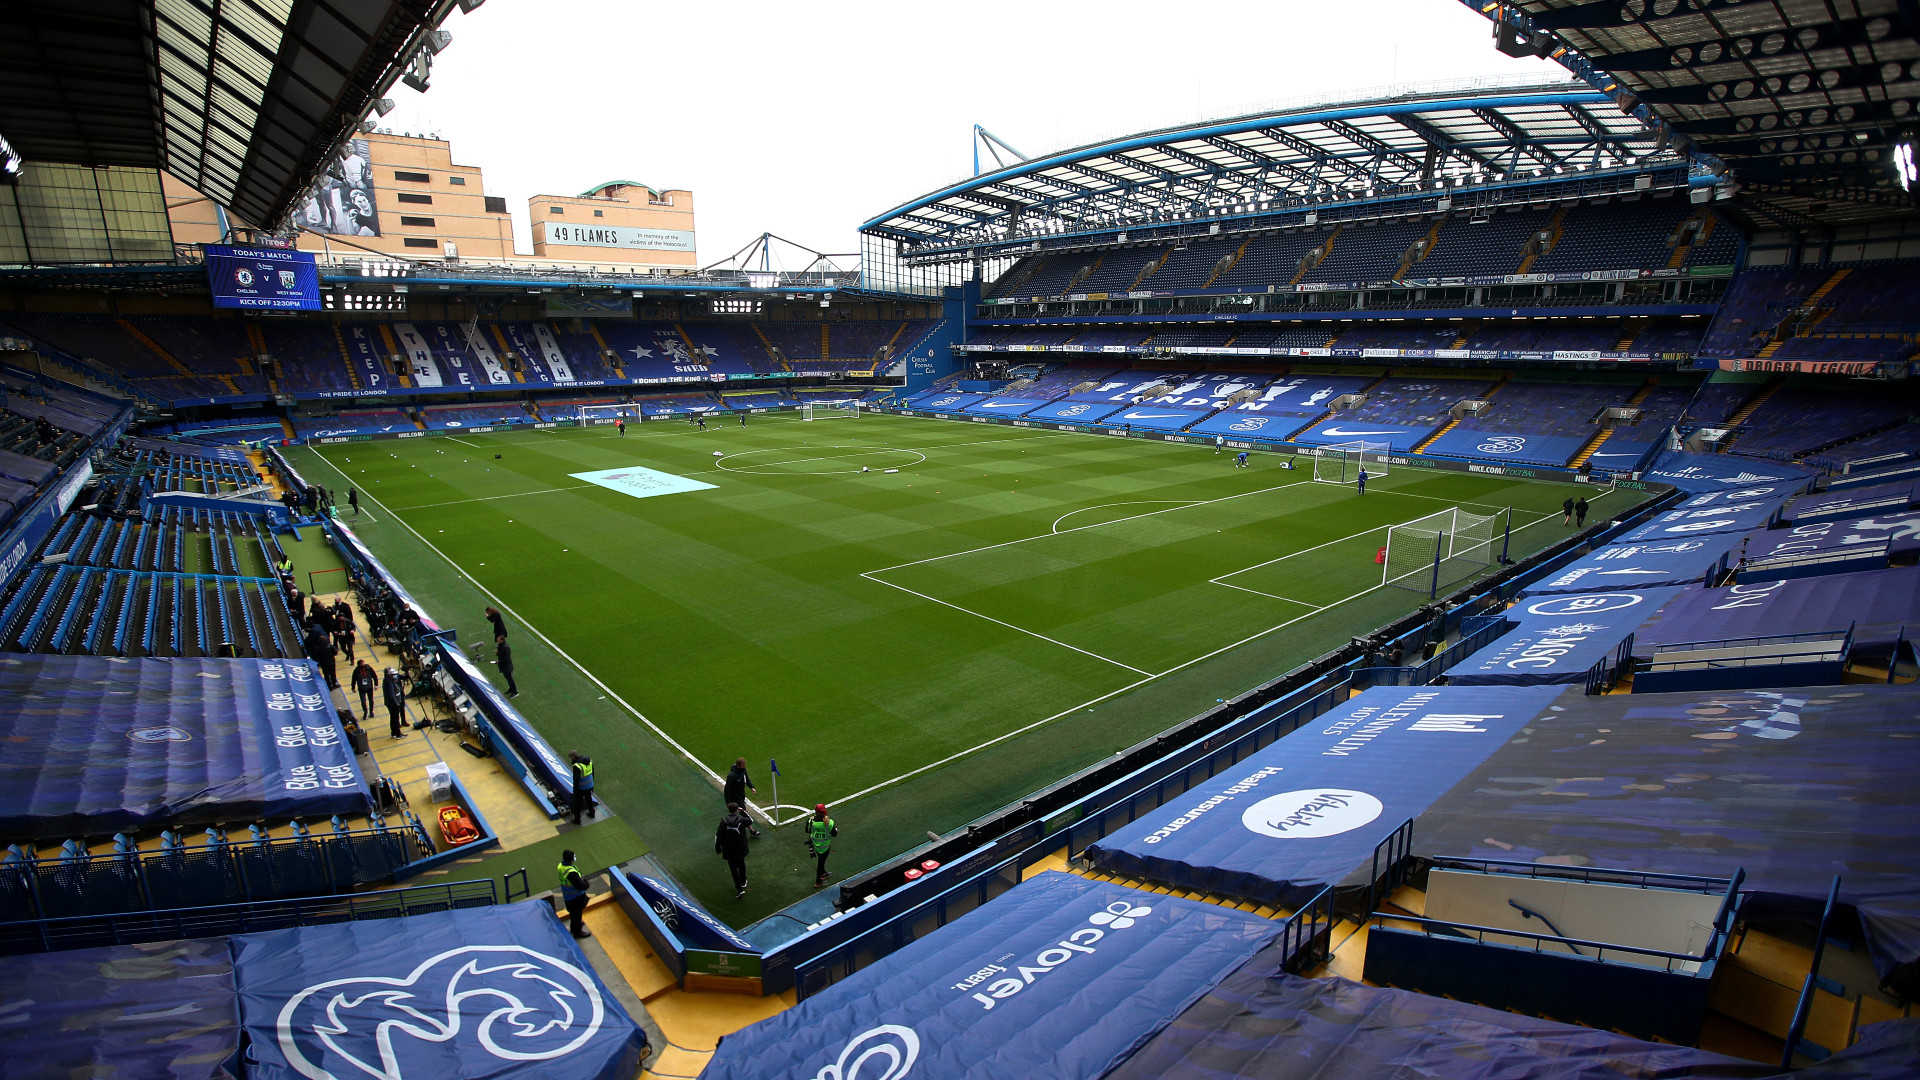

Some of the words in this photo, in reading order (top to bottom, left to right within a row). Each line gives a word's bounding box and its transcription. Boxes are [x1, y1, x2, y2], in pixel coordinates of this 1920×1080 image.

[259, 236, 285, 246] Three
[554, 227, 568, 240] 49
[575, 228, 618, 243] FLAMES
[233, 249, 265, 257] TODAY'S
[352, 327, 380, 386] KEEP
[404, 332, 430, 376] THE
[437, 326, 471, 384] BLUE
[508, 325, 549, 382] FLYING
[539, 327, 566, 378] HIGH
[1555, 352, 1589, 360] HASTINGS
[1746, 360, 1801, 372] DROGBA
[1812, 362, 1865, 375] LEGEND
[1651, 470, 1715, 480] HUBLOT
[1506, 636, 1588, 669] MSC
[260, 663, 283, 681] Blue
[267, 692, 296, 712] Blue
[298, 692, 322, 712] Fuel
[277, 724, 305, 748] Blue
[309, 724, 340, 747] Fuel
[1321, 692, 1441, 756] MILLENNIUM
[1322, 706, 1381, 736] HOTELS
[285, 764, 320, 791] Blue
[323, 763, 357, 790] Fuel
[1222, 765, 1284, 797] Health
[1143, 795, 1236, 845] insurance
[1266, 793, 1354, 832] Vitality
[971, 928, 1105, 1010] clover
